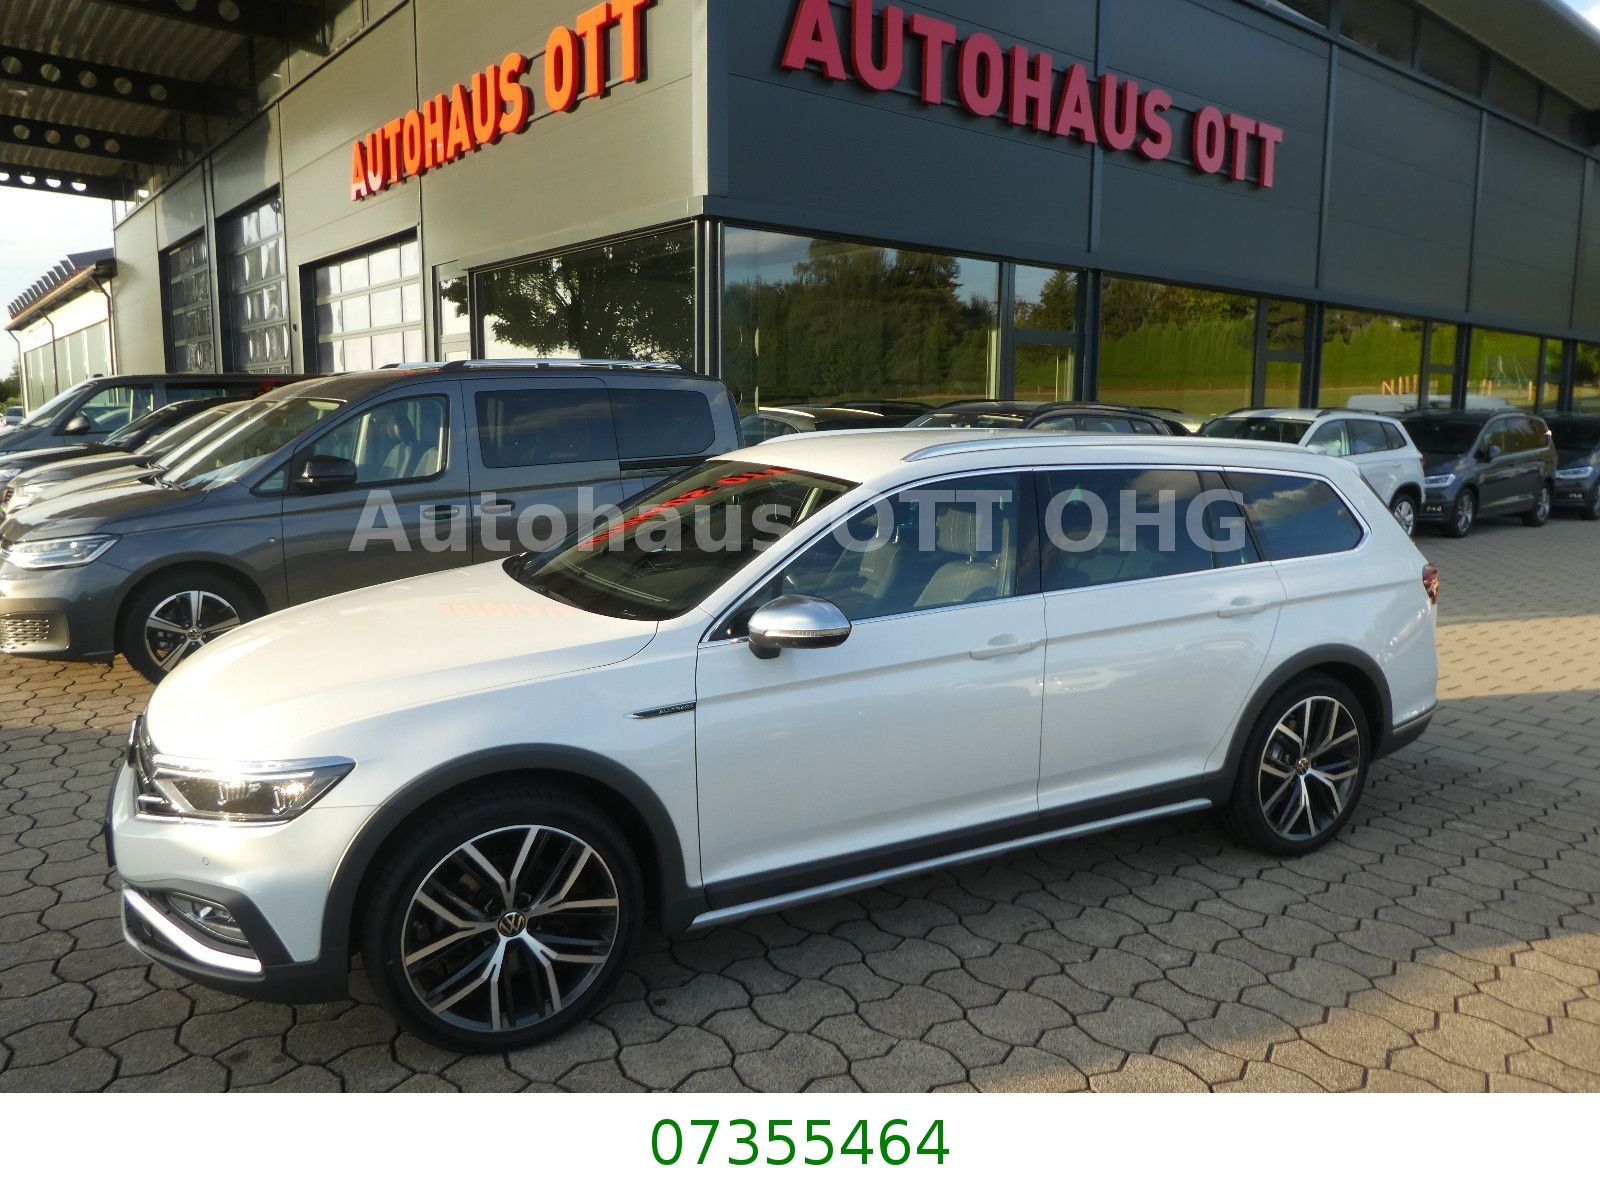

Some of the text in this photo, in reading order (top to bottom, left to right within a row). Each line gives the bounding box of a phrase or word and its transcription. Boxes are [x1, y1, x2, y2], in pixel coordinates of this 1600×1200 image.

[351, 0, 650, 201] AUTOHAUS OTT
[781, 0, 1284, 189] AUTOHAUS OTT
